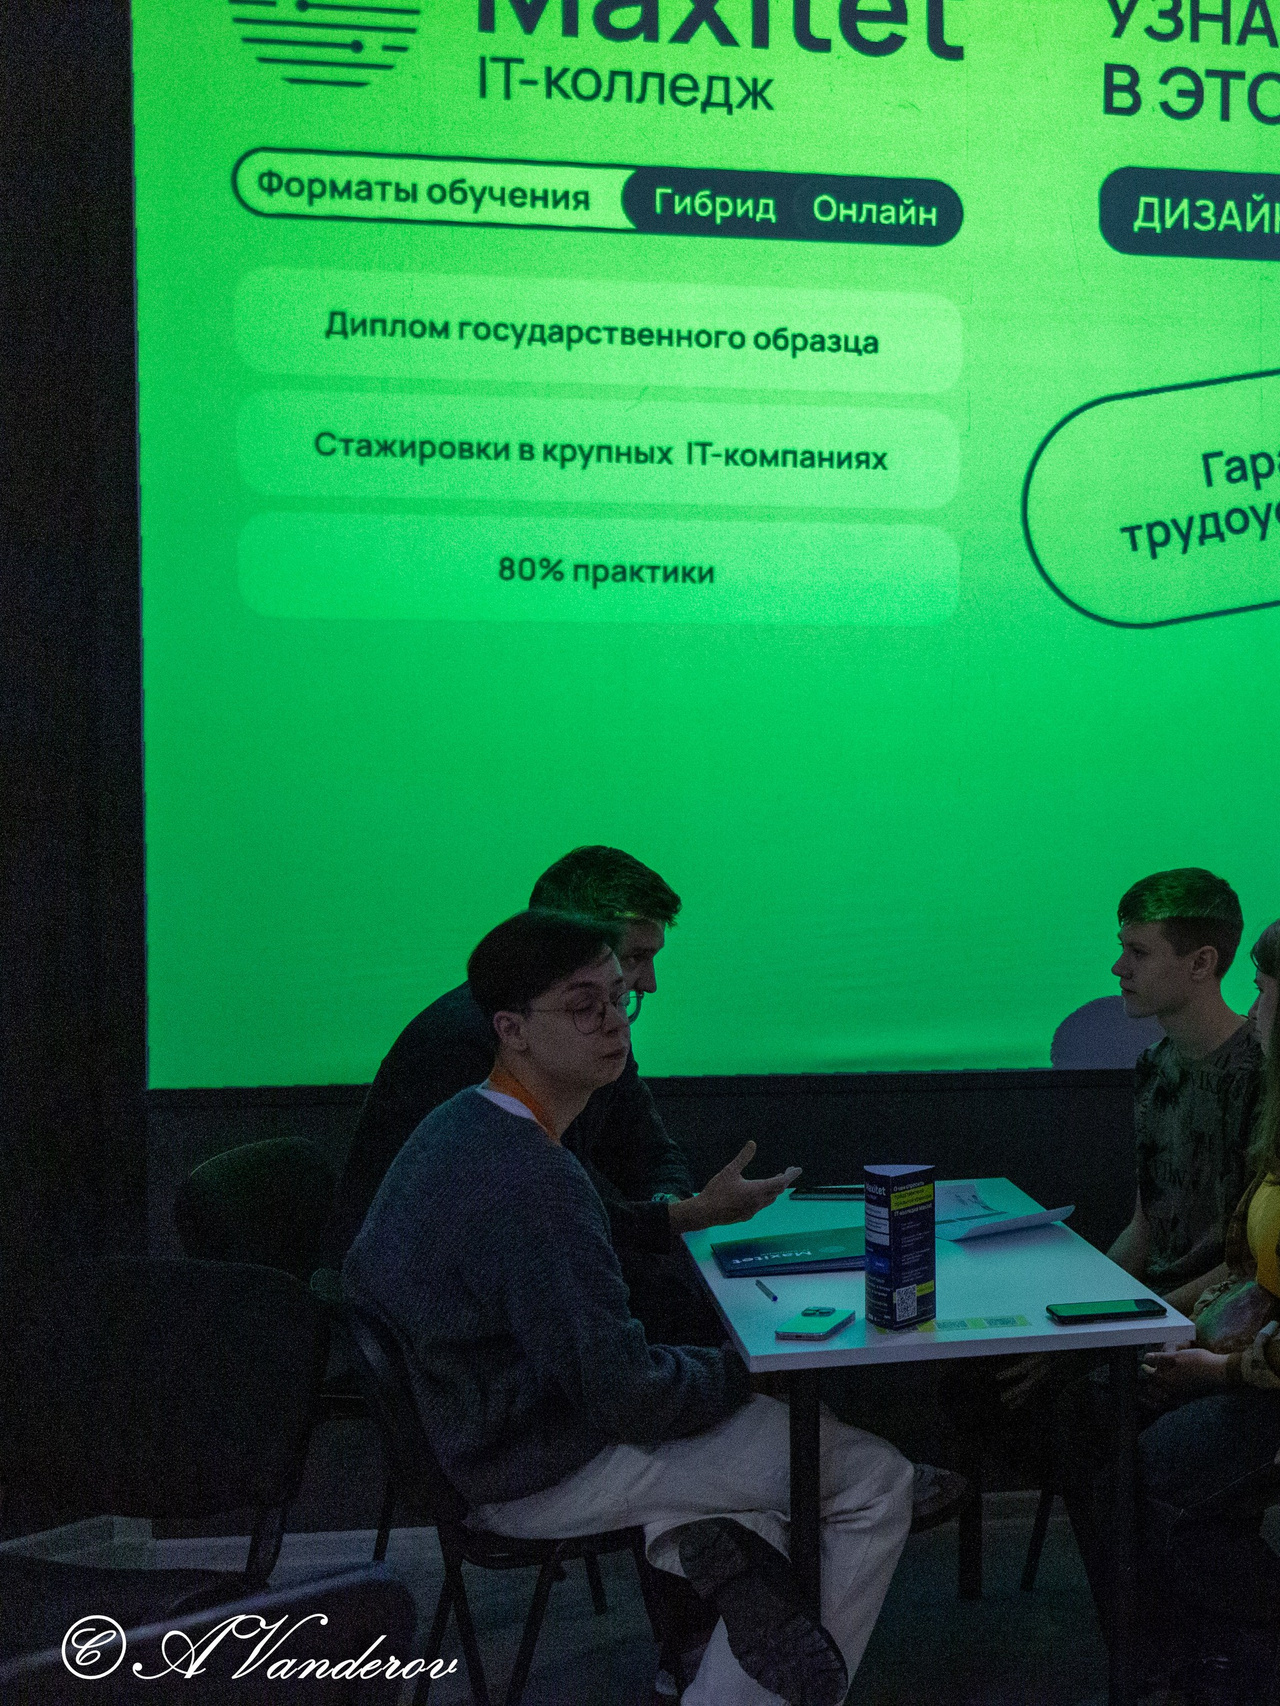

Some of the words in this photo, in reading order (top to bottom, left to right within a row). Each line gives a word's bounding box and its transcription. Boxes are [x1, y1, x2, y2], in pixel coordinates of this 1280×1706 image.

[478, 56, 774, 115] IT-колледж
[1103, 63, 1141, 116] В
[257, 169, 418, 206] Форматы
[427, 178, 590, 213] обучения
[654, 187, 777, 224] Гибрид
[812, 194, 938, 227] Онлайн
[324, 310, 450, 340] Диплом
[458, 320, 746, 351] государственного
[753, 327, 880, 358] образца
[313, 431, 511, 465] Стажировки
[518, 441, 536, 462] в
[543, 442, 673, 470] крупных
[687, 440, 888, 471] IT-компаниях
[498, 556, 566, 583] 80%
[573, 563, 715, 589] практики
